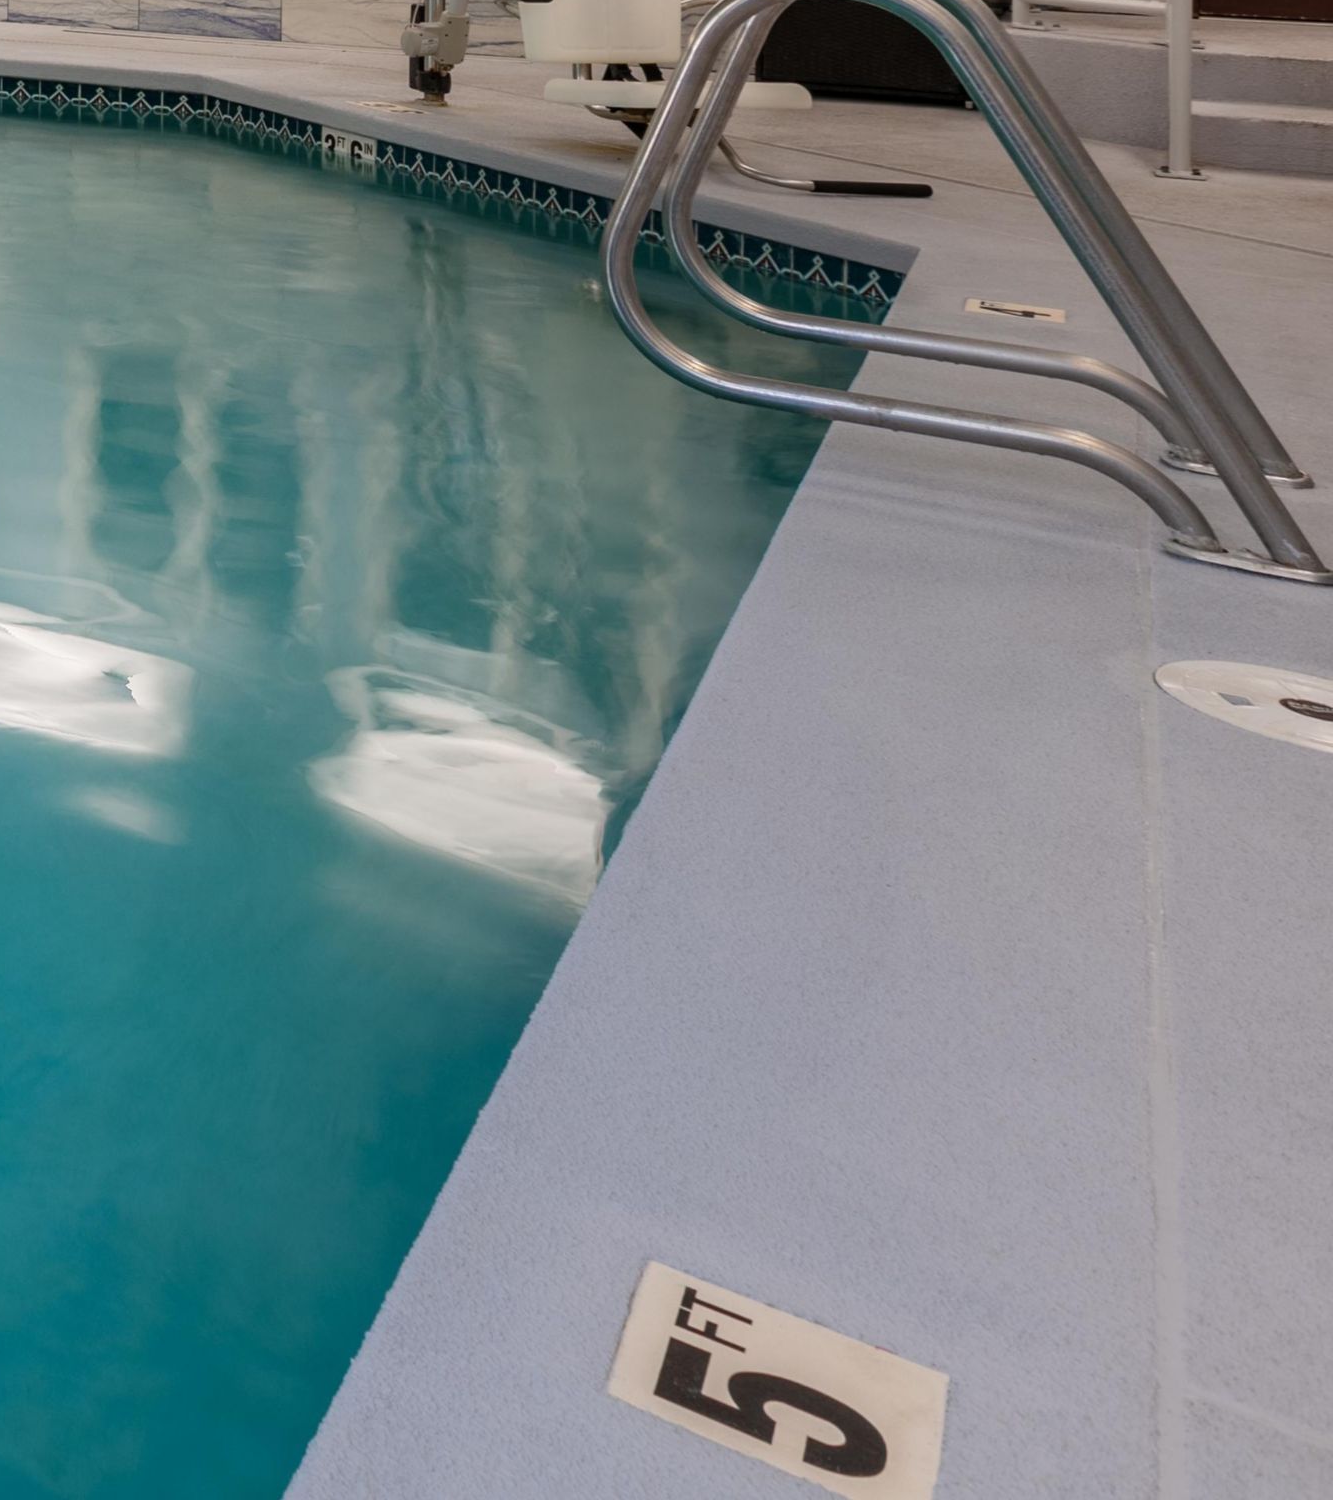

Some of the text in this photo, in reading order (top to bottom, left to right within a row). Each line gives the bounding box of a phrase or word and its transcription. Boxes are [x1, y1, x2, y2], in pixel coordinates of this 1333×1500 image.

[337, 137, 346, 149] FT
[364, 142, 373, 156] IN
[653, 1286, 889, 1479] 5 FT
